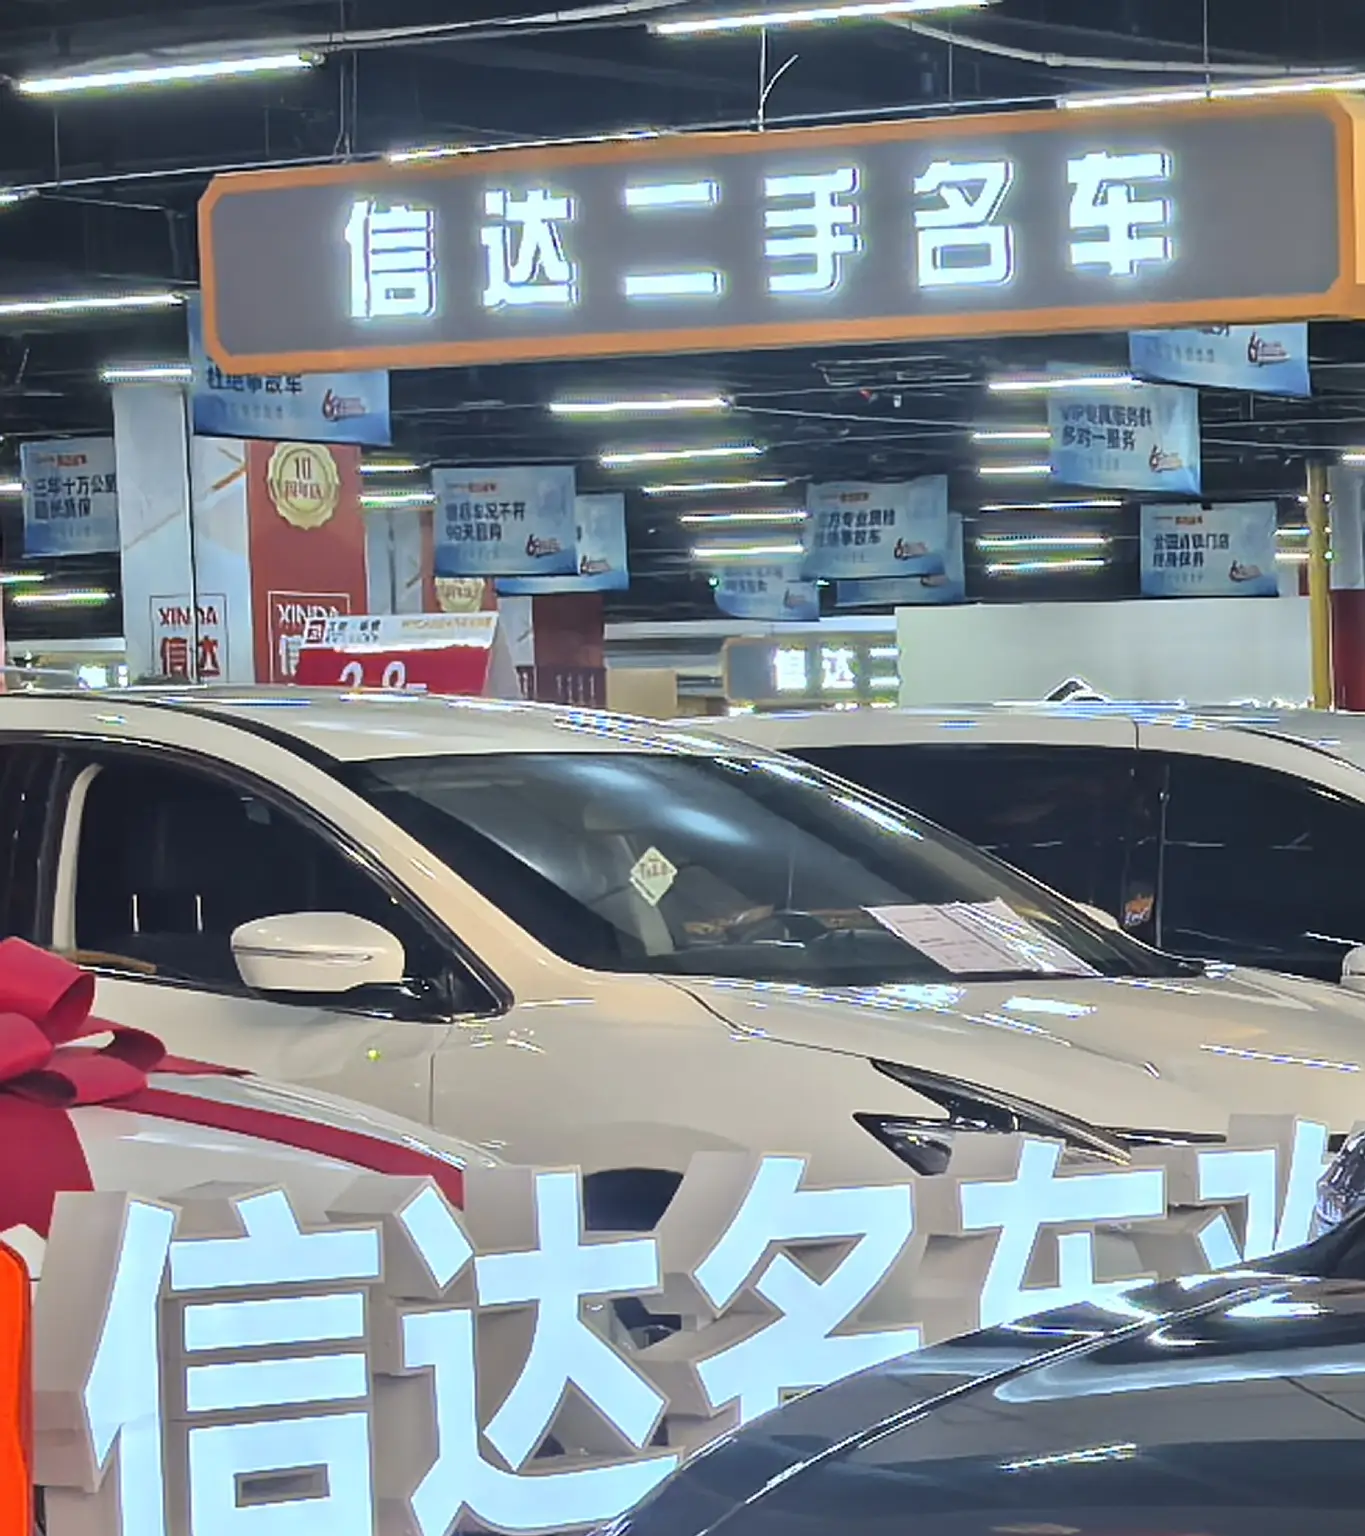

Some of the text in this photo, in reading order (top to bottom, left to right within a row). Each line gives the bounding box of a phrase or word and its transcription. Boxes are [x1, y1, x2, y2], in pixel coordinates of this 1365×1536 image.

[345, 151, 1173, 318] 信达二手名车
